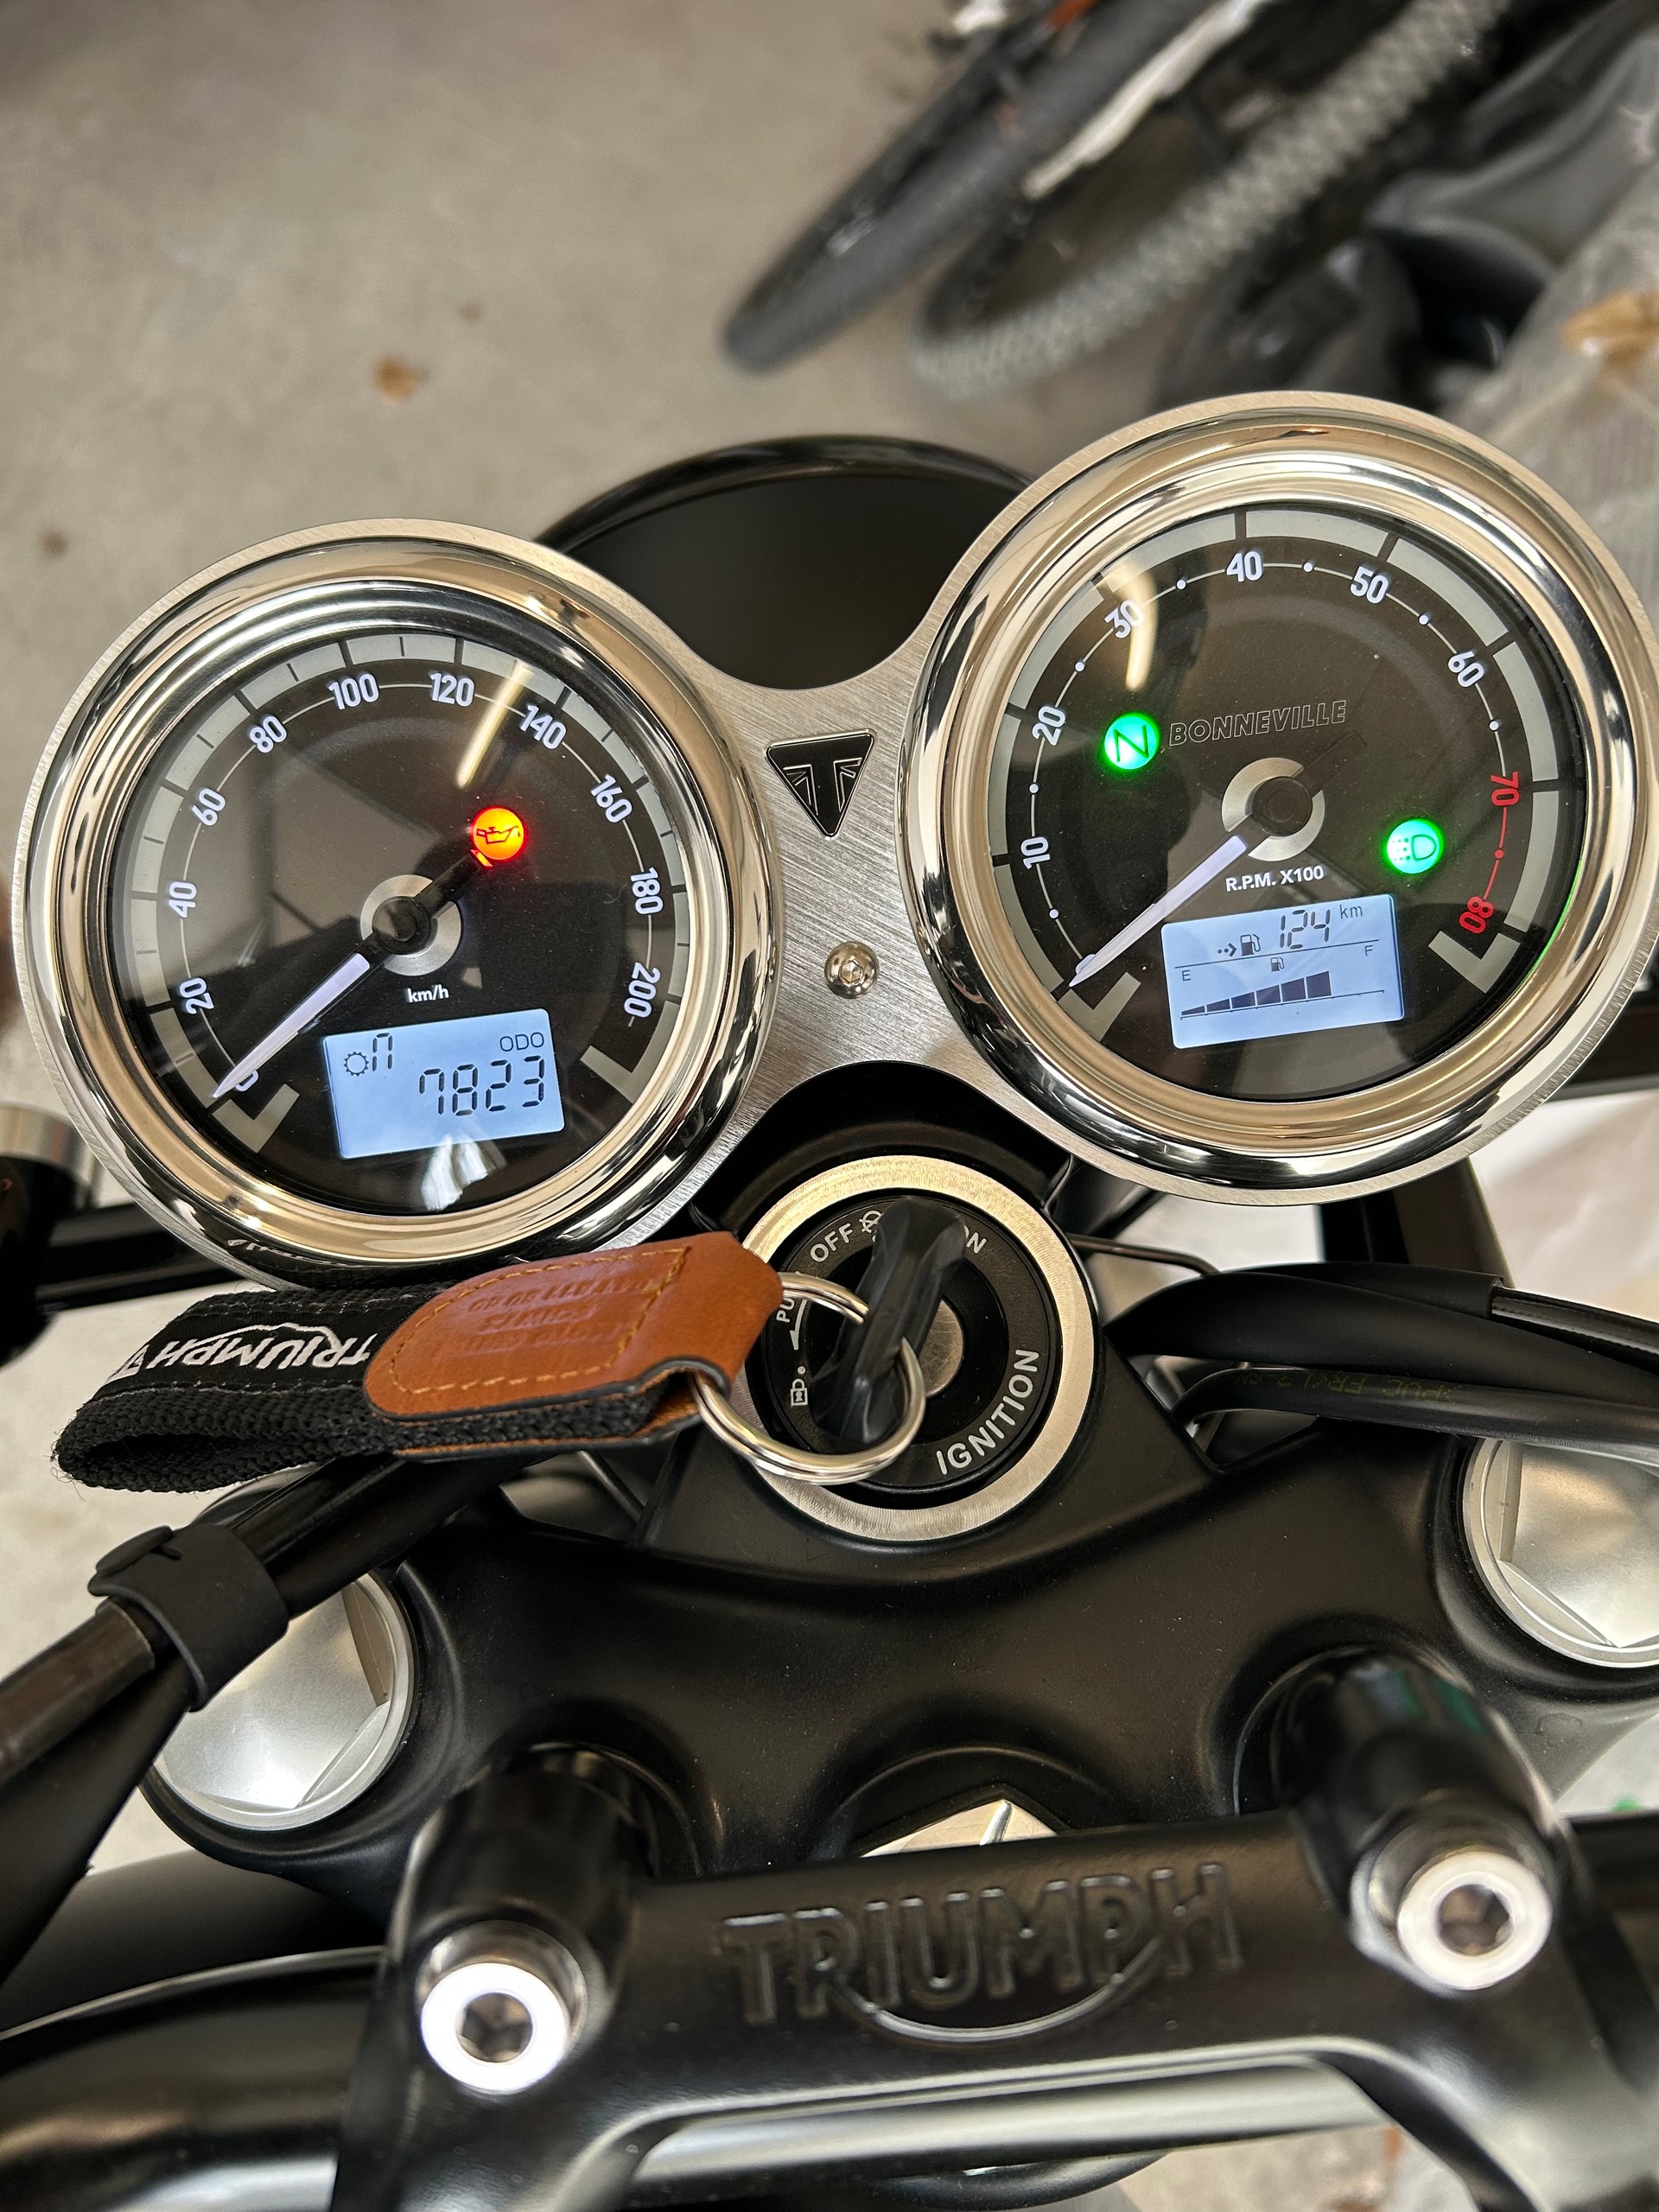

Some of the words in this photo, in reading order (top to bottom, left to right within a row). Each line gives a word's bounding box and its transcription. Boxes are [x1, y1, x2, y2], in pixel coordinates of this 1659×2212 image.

[1226, 550, 1264, 582] 40
[1350, 566, 1389, 604] 50
[1104, 600, 1145, 639] 30
[1448, 650, 1484, 688] 60
[327, 672, 379, 709] 100
[430, 671, 474, 708] 120
[247, 715, 288, 754] 80
[519, 704, 567, 749] 140
[1033, 705, 1066, 747] 20
[1168, 700, 1347, 747] BONNEVILLE
[191, 787, 227, 827] 60
[590, 773, 632, 824] 160
[1491, 771, 1520, 807] 70
[1020, 836, 1050, 868] 10
[630, 867, 664, 915] 180
[1225, 872, 1277, 893] R.P.M.
[1280, 865, 1325, 886] X100
[168, 880, 197, 918] 40
[1459, 895, 1495, 935] 80
[1279, 909, 1331, 950] 124
[1340, 904, 1363, 919] km
[1364, 944, 1373, 957] F
[178, 976, 214, 1014] 20
[407, 983, 450, 1003] km/h
[624, 962, 662, 1019] 200
[1181, 969, 1192, 982] E
[499, 1032, 545, 1052] ODO
[418, 1055, 545, 1116] 7823
[810, 1223, 854, 1262] OFF
[150, 1323, 378, 1370] TRIUMPH
[936, 1349, 1039, 1475] IGNITION
[721, 1862, 1245, 2025] TRIUMPH
